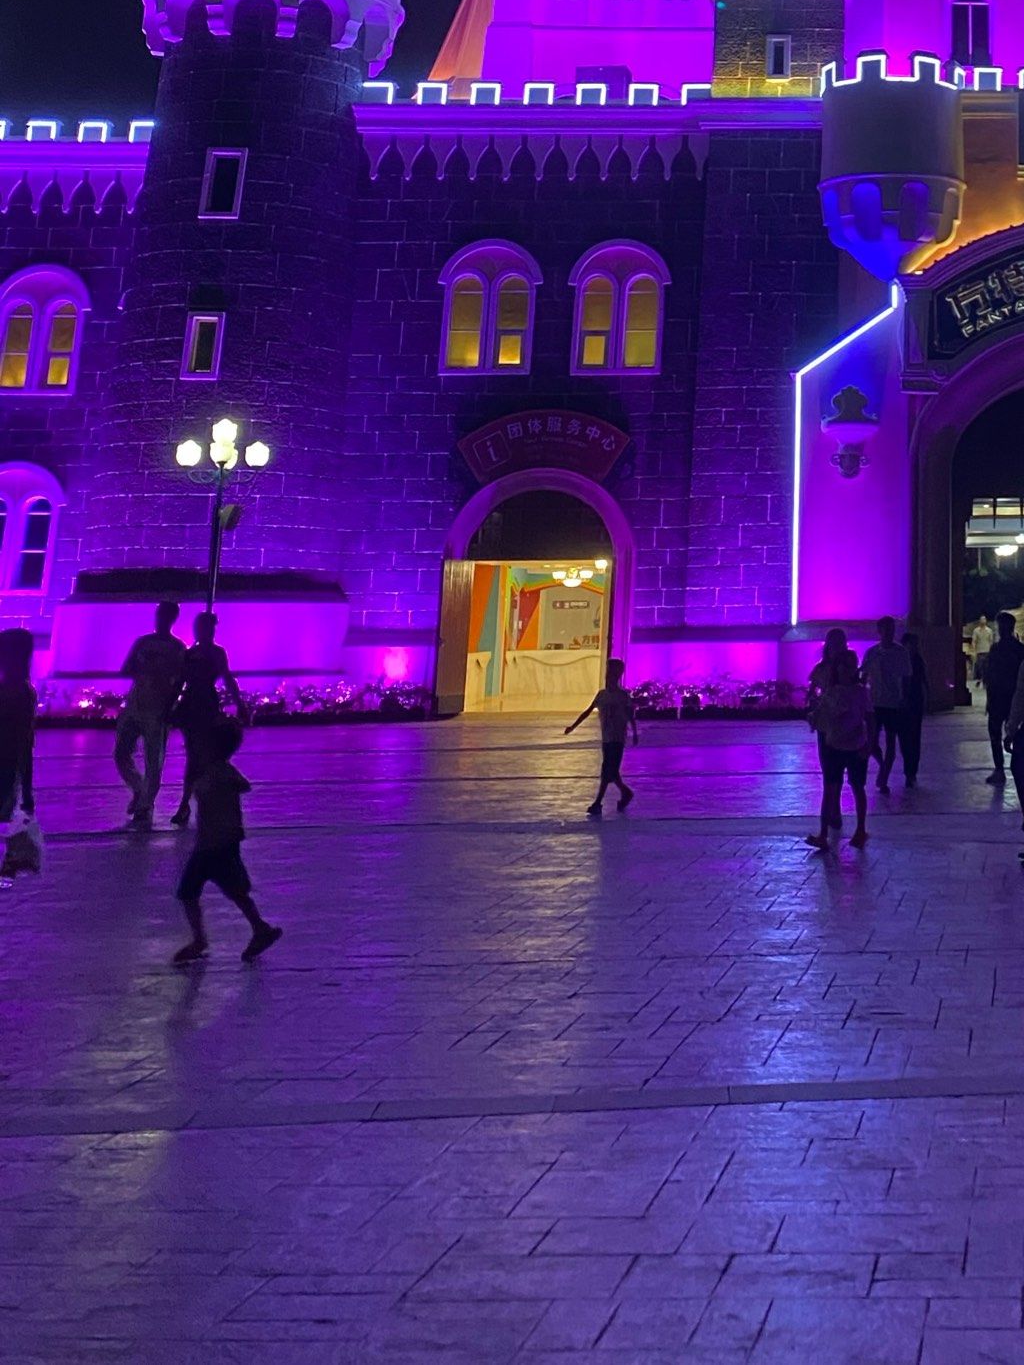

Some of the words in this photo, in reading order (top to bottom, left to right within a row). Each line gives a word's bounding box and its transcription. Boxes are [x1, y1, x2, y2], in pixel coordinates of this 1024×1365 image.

[507, 416, 616, 451] 团体服务中心
